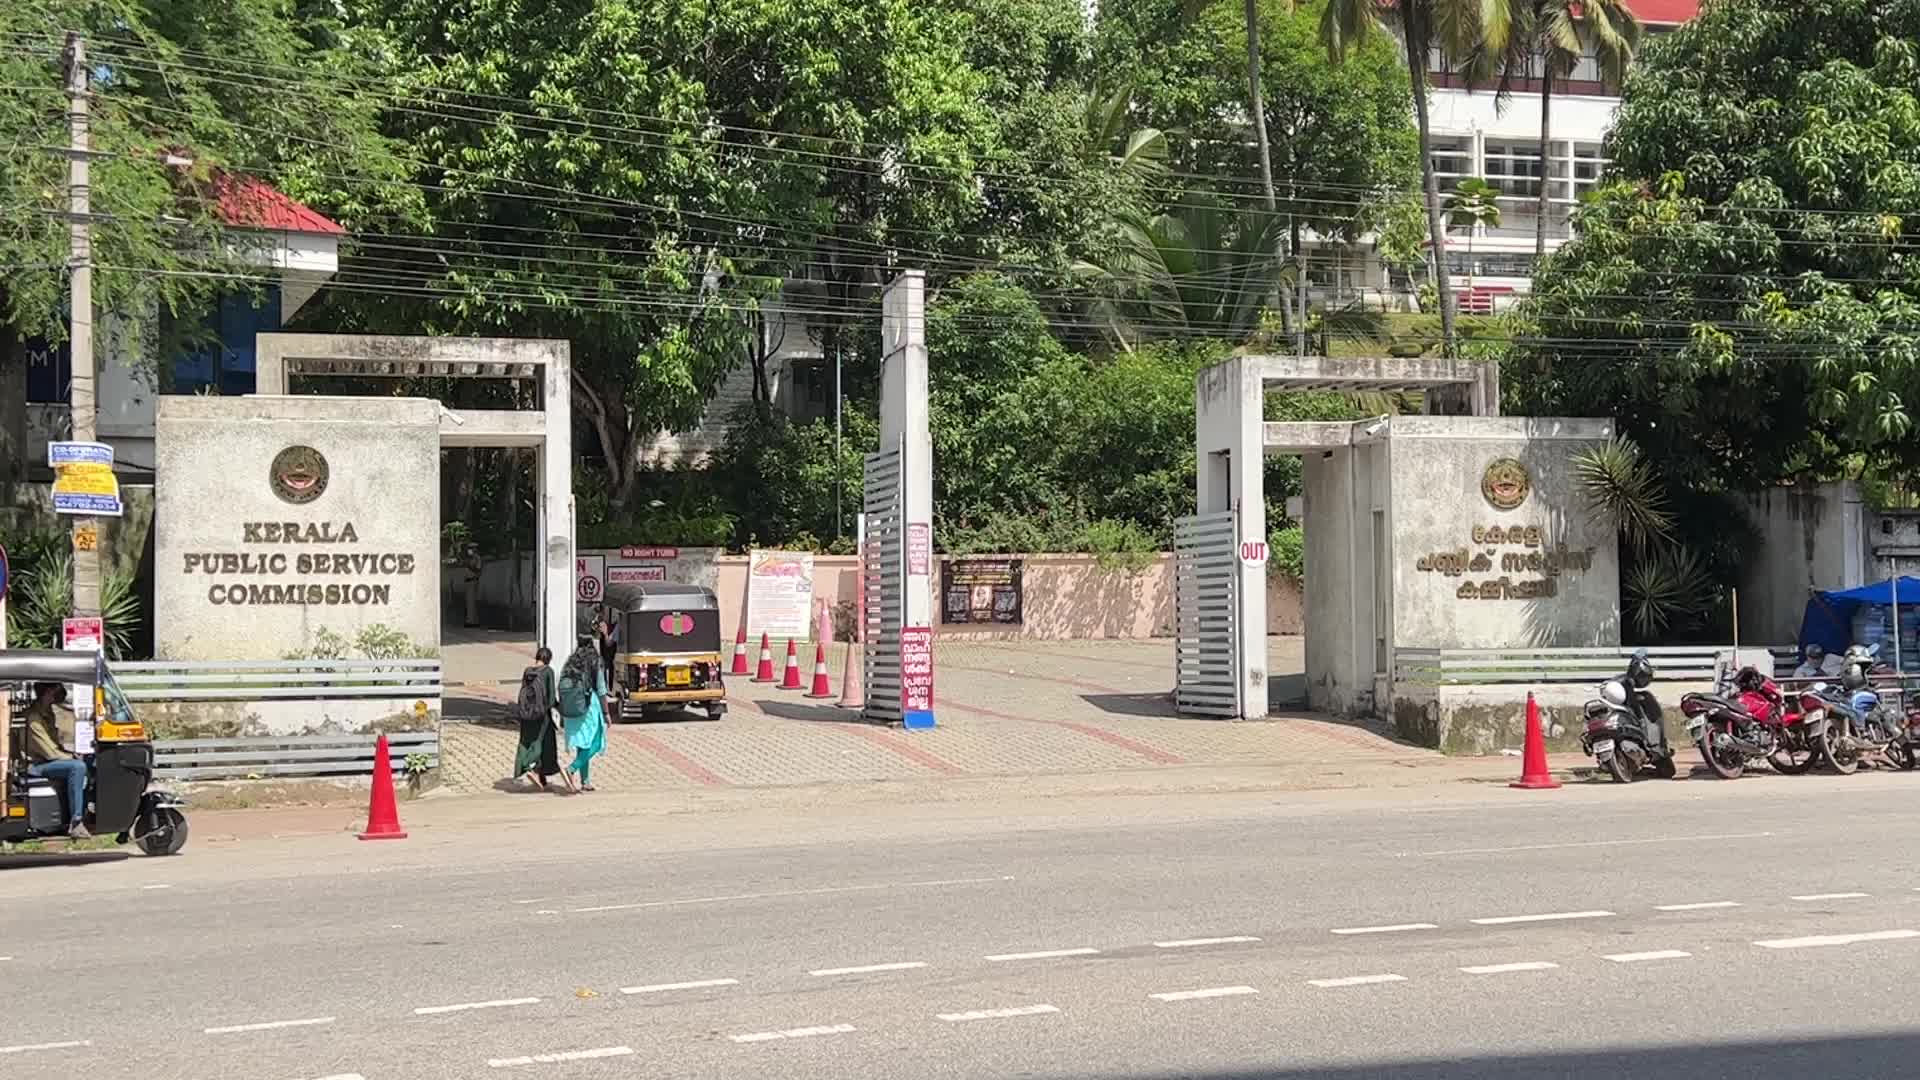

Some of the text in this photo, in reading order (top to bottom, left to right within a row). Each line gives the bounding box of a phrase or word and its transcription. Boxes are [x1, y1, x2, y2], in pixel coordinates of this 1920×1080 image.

[243, 522, 359, 544] KERALA
[1472, 525, 1544, 548] കേരള
[1241, 542, 1265, 561] OUT
[183, 553, 416, 575] PUBLIC SERVICE
[577, 560, 586, 572] N
[1416, 549, 1497, 577] പബ്ലിക്
[208, 584, 391, 605] COMMISSION
